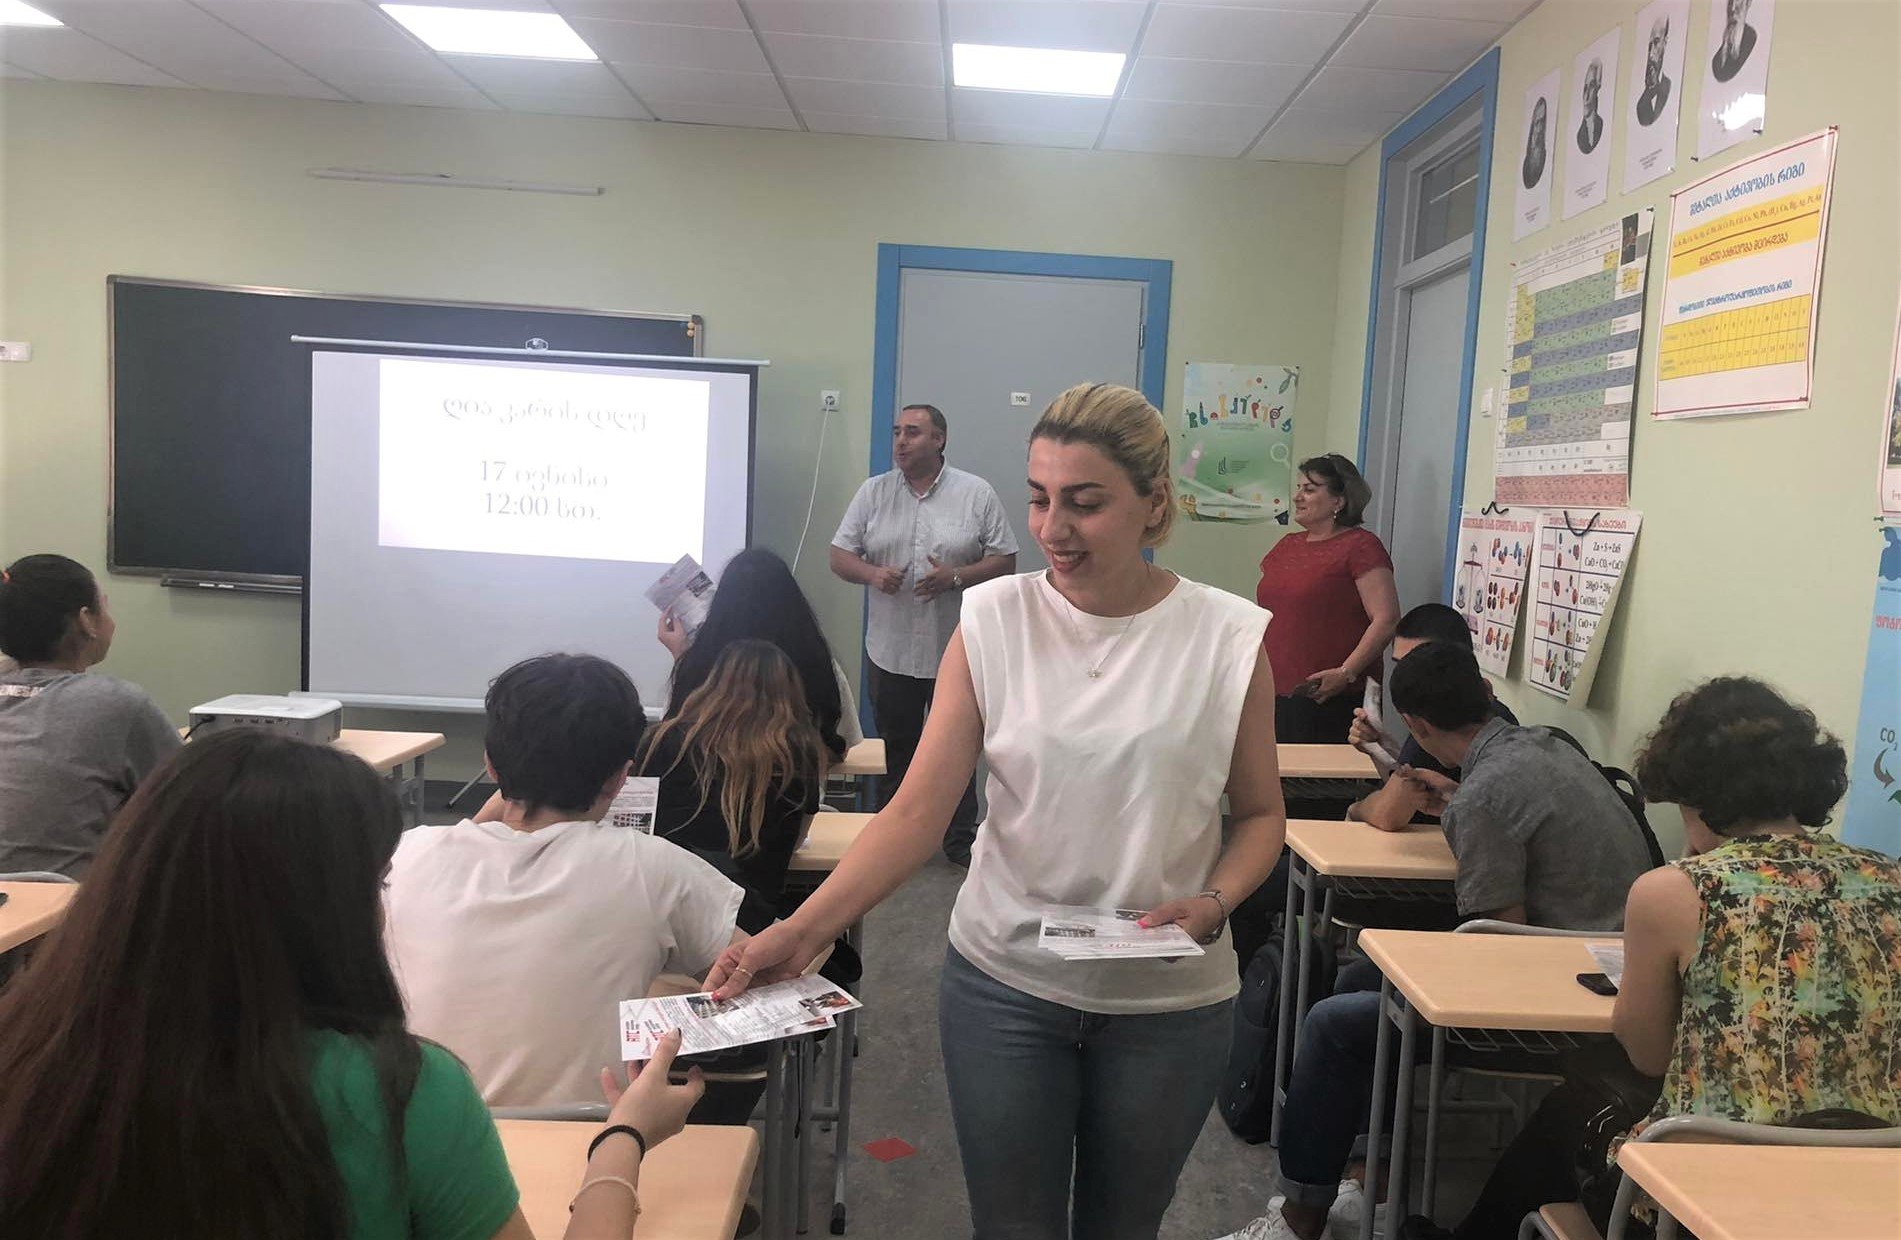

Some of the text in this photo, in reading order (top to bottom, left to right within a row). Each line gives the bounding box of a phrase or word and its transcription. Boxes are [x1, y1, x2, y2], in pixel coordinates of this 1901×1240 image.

[1777, 162, 1805, 184] რიგი
[442, 398, 649, 433] ღია კარის დღე
[480, 460, 609, 492] 17 ივნისი
[485, 492, 549, 517] 12:00
